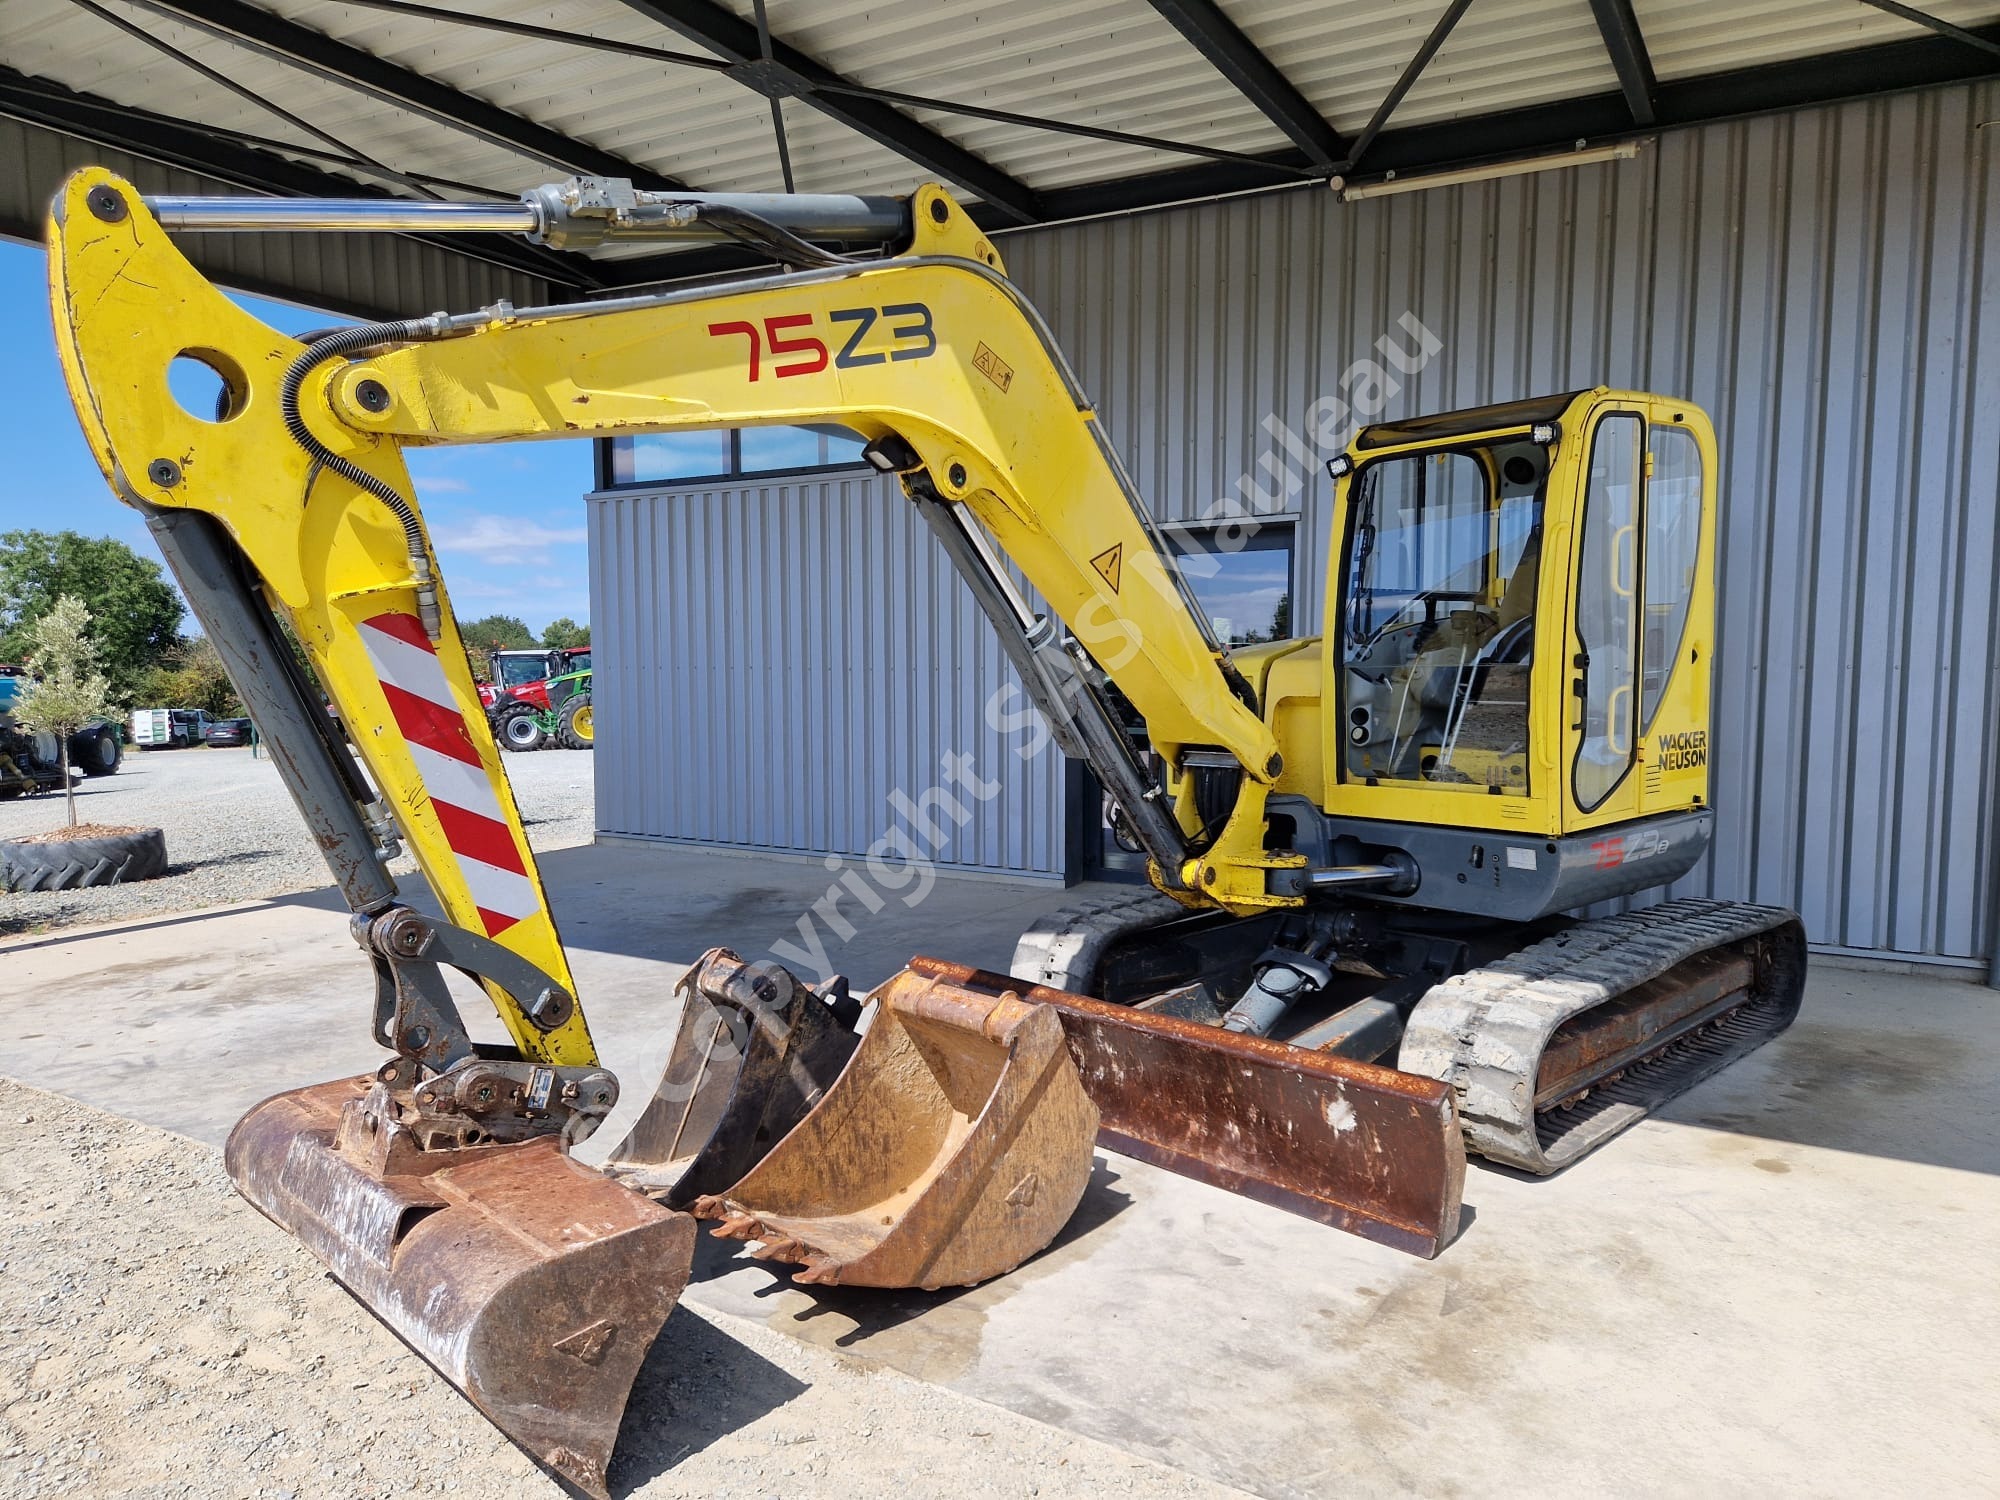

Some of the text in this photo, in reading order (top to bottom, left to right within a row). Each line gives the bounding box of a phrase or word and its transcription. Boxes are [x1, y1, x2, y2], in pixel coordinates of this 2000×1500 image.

[708, 302, 937, 383] 75Z3
[1658, 730, 1706, 752] WACKER
[1658, 749, 1706, 771] NEUSON
